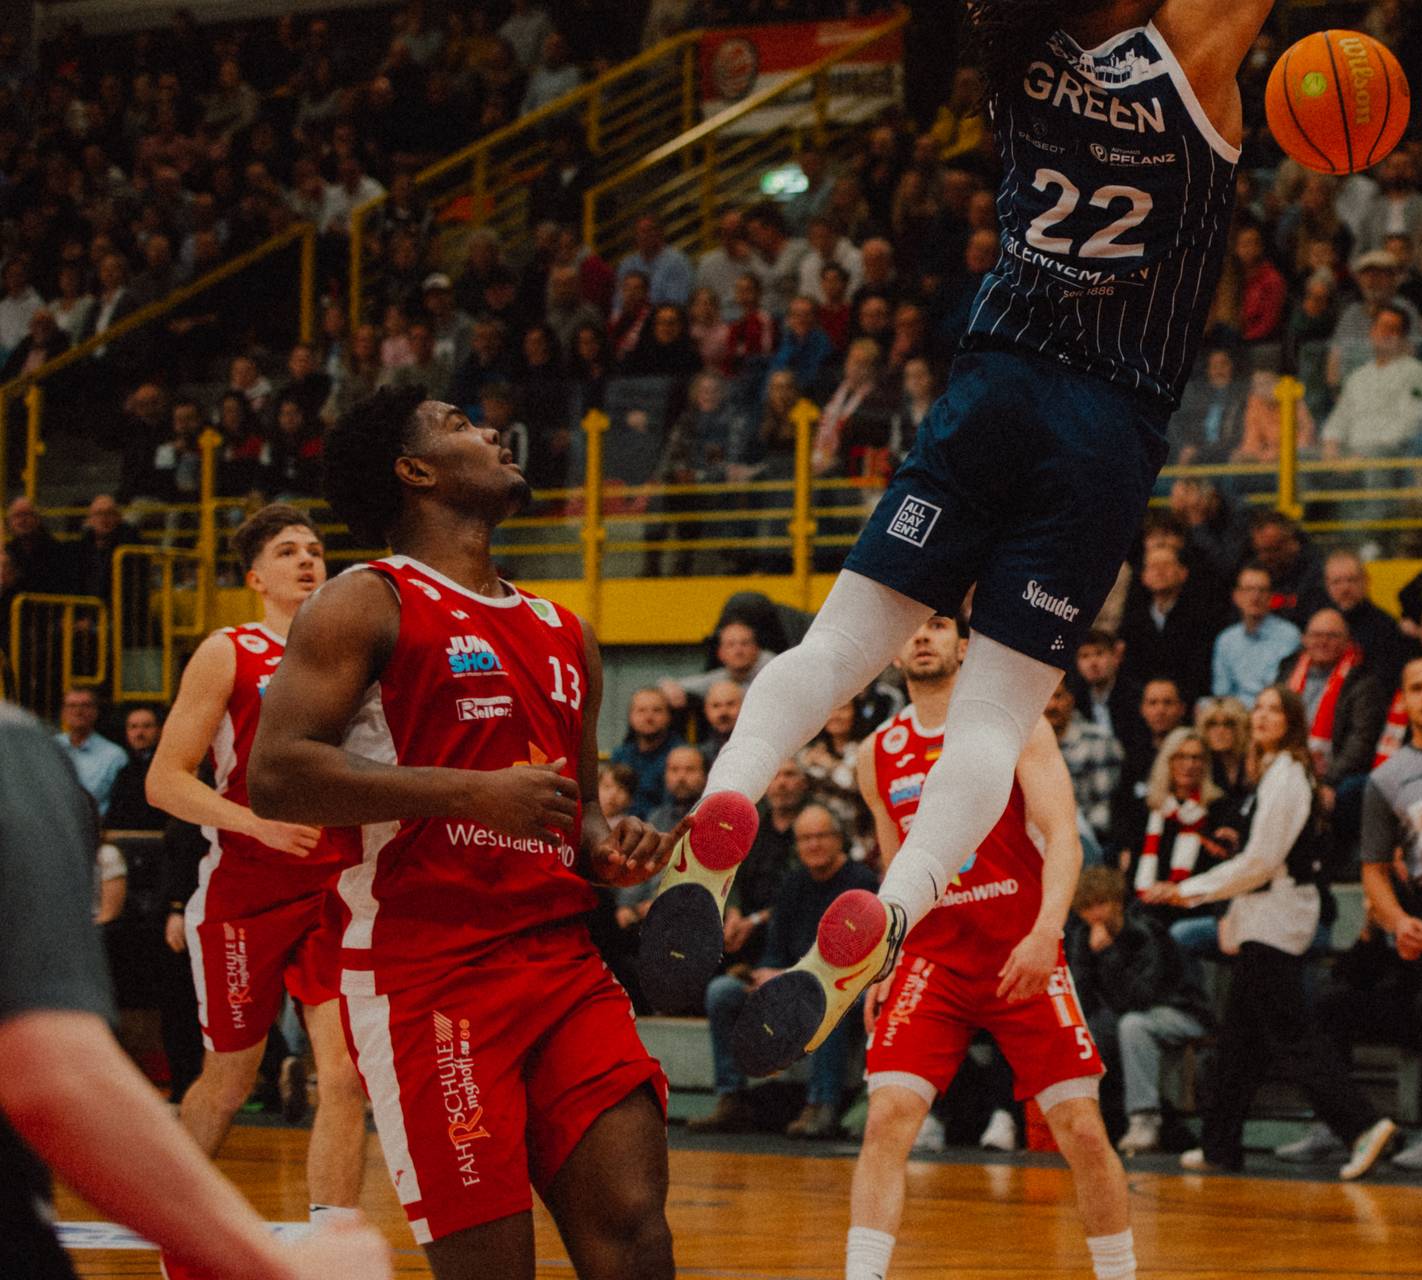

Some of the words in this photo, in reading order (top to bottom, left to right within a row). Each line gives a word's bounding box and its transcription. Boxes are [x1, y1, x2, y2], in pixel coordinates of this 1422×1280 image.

[1023, 60, 1166, 134] GREEN
[1338, 37, 1374, 125] Wilson
[1109, 152, 1177, 165] PFLANZ
[1025, 167, 1154, 259] 22
[892, 520, 920, 540] ENT.
[898, 510, 925, 528] DAY
[904, 502, 926, 519] ALL
[1022, 579, 1080, 623] Stauder
[548, 655, 582, 710] 13
[436, 1041, 481, 1187] FAHRSCHULE
